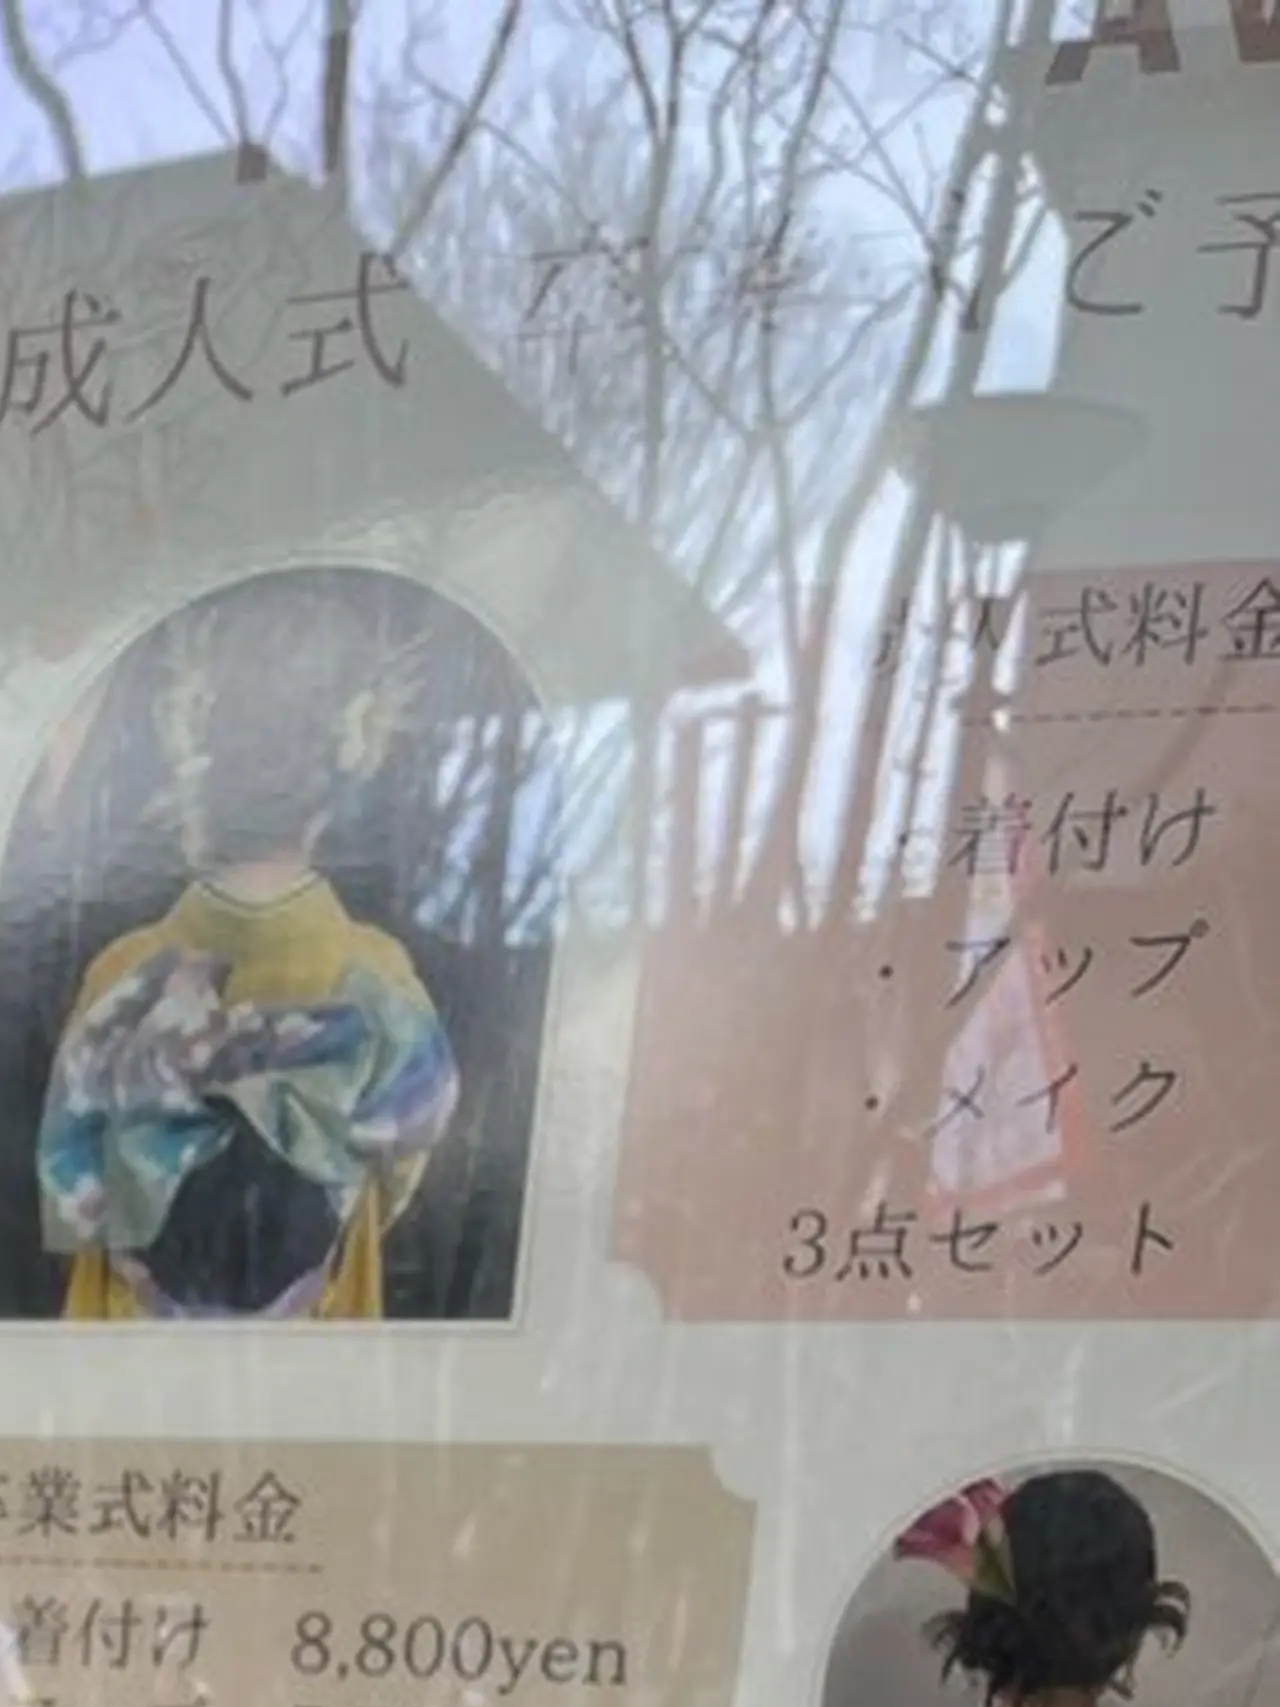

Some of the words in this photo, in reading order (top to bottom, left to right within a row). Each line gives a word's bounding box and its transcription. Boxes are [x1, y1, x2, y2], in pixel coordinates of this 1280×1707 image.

[782, 1201, 1176, 1282] 3点セット
[290, 1610, 629, 1697] 8,800yen
